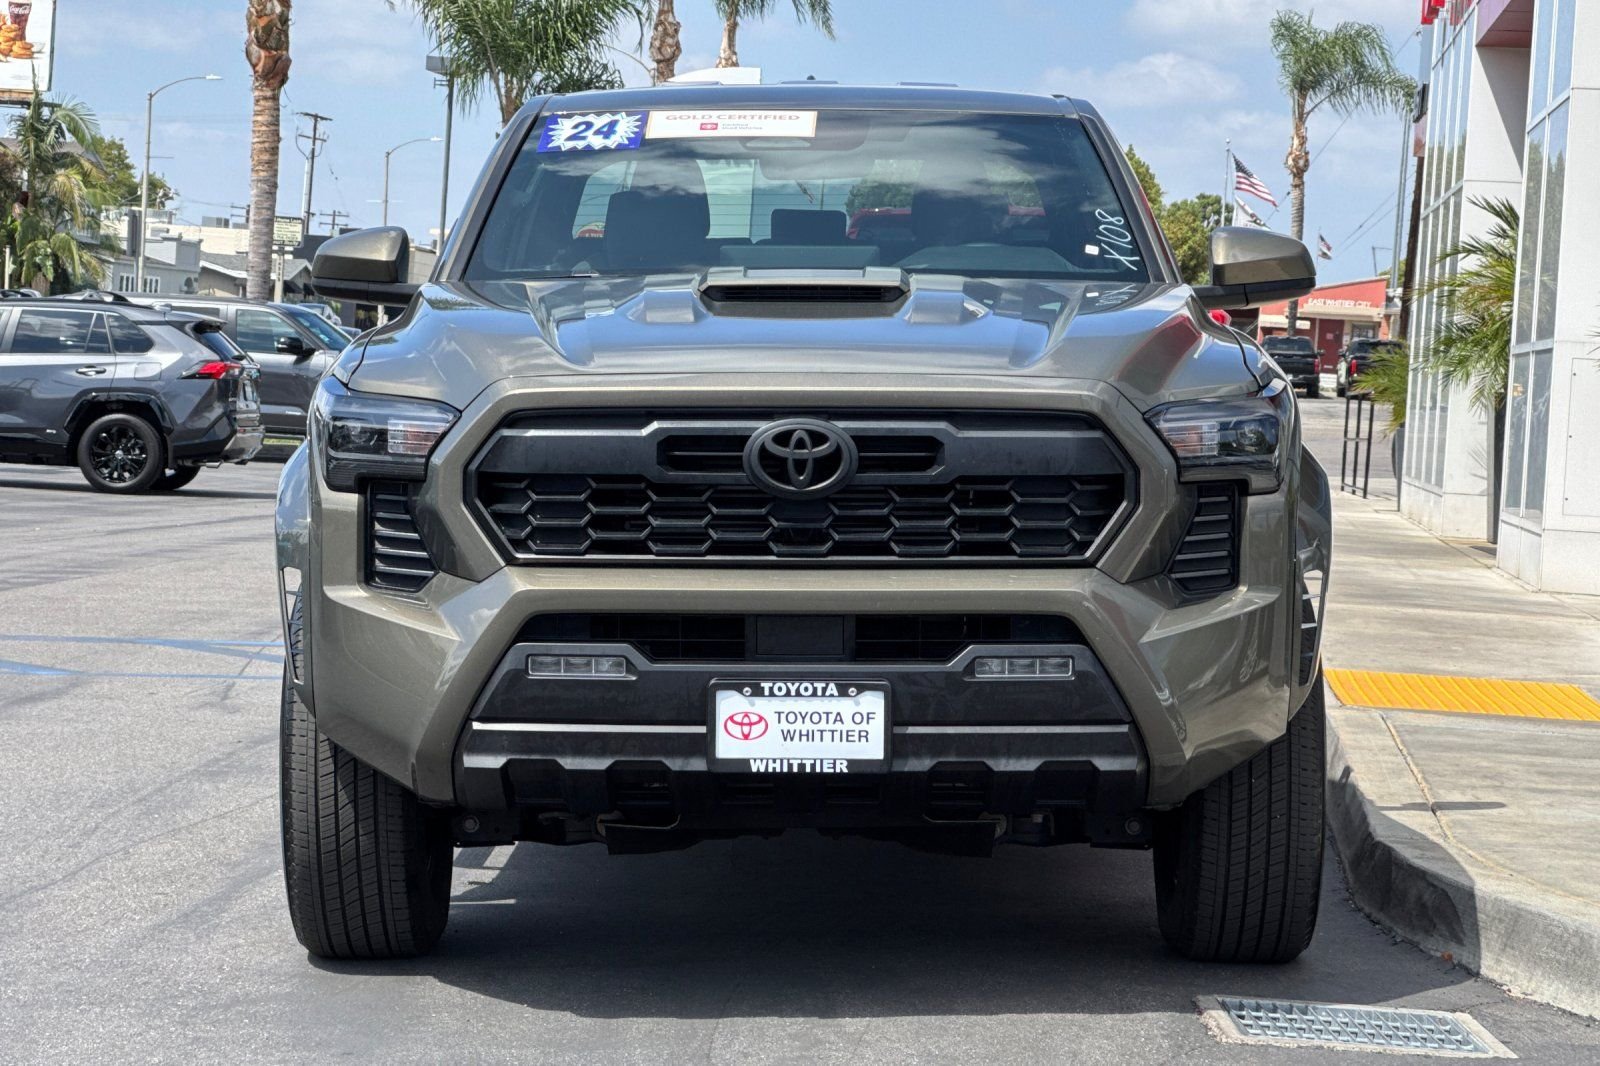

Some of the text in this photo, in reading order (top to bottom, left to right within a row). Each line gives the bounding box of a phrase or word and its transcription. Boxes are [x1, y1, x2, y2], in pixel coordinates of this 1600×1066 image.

[564, 118, 618, 141] 24
[760, 682, 839, 696] TOYOTA
[774, 711, 876, 725] TOYOTA OF
[780, 729, 870, 743] WHITTIER
[750, 759, 848, 773] WHITTIER
